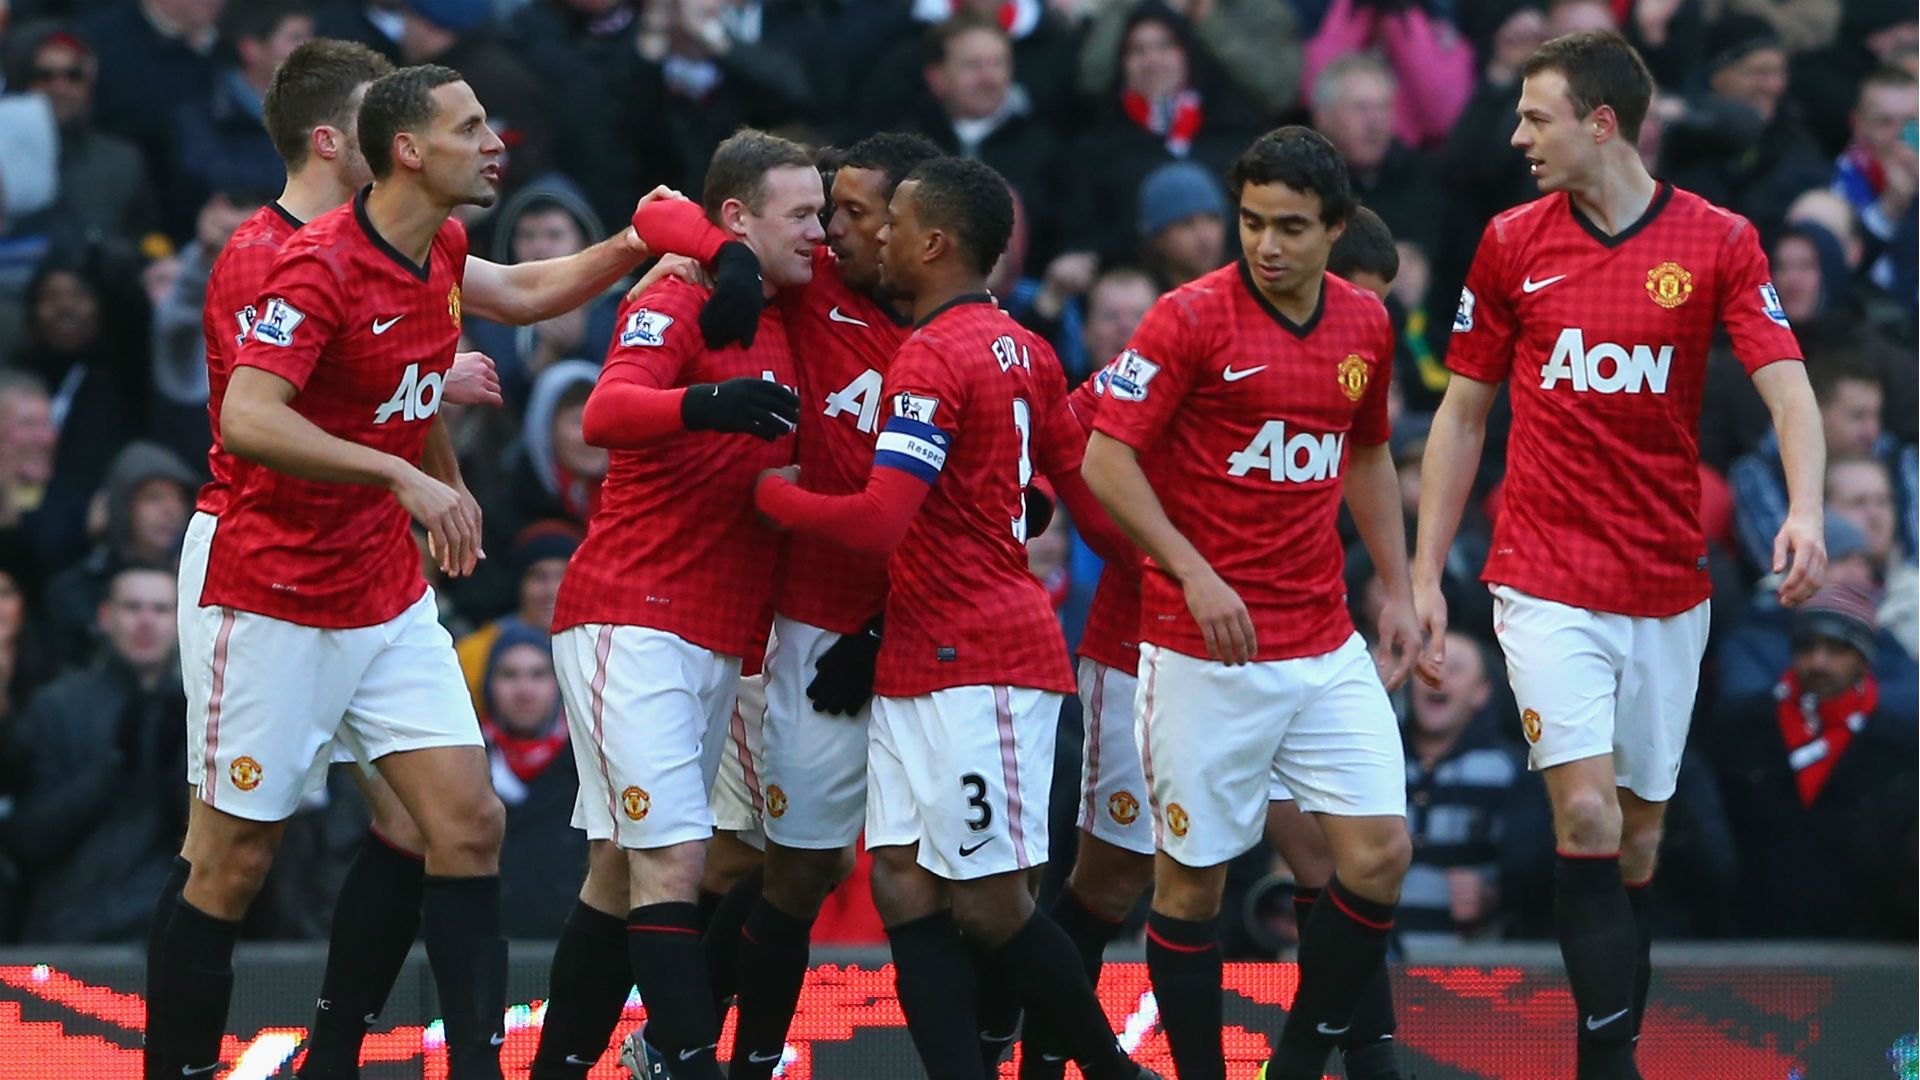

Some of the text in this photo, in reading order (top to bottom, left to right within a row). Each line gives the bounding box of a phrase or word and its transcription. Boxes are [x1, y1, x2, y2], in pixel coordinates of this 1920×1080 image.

[1540, 328, 1675, 394] AON
[373, 362, 448, 424] AO
[1227, 420, 1345, 483] AON
[960, 772, 993, 833] 3
